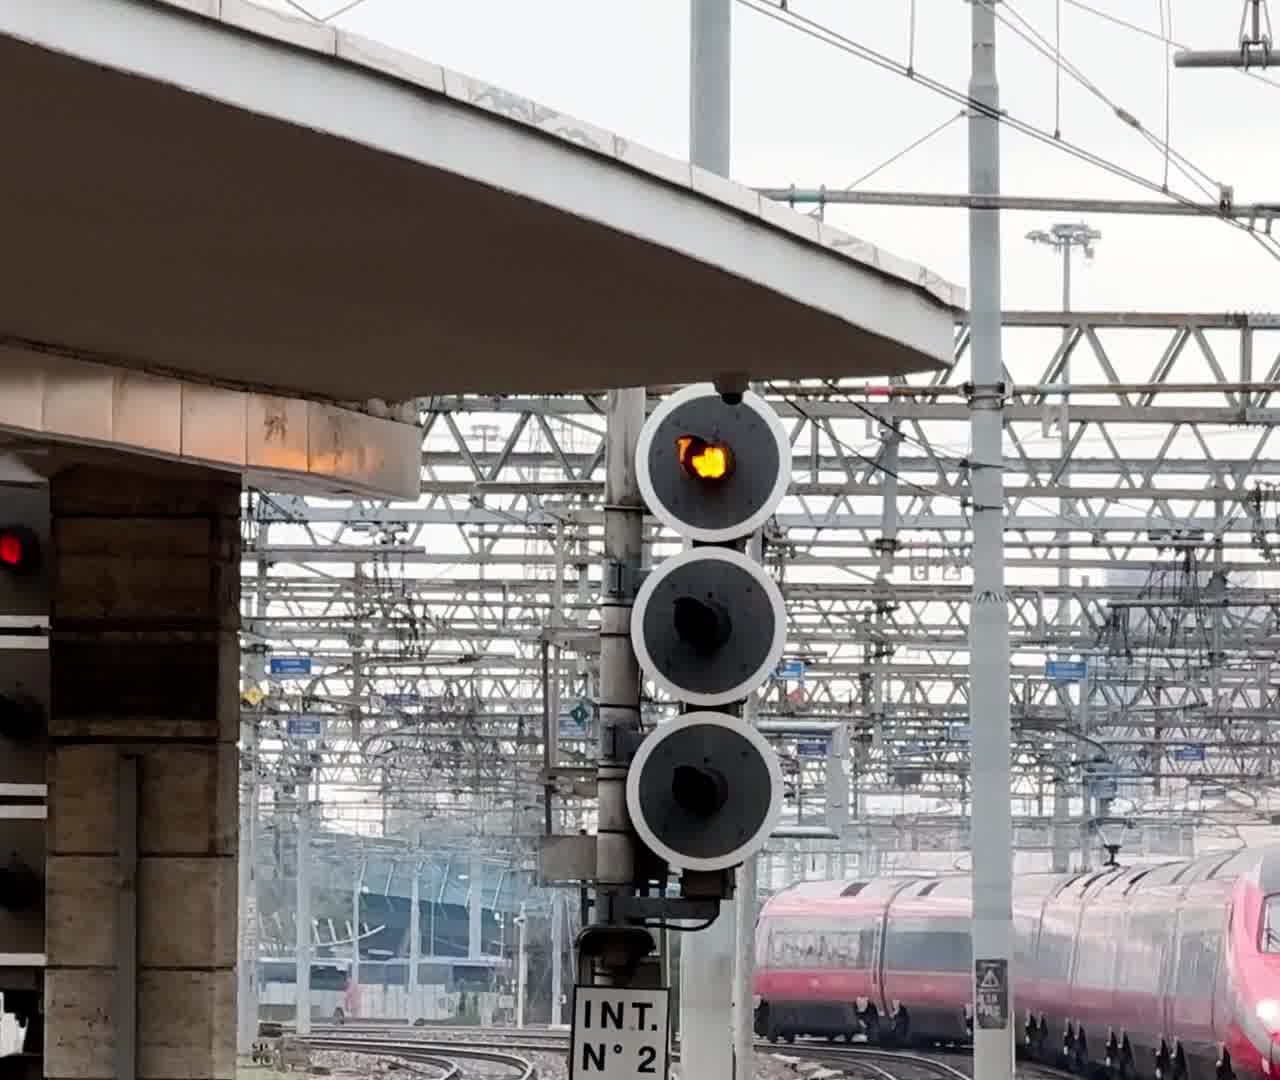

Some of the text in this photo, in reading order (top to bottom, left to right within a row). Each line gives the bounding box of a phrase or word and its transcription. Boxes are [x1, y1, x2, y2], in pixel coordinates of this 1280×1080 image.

[584, 1000, 658, 1031] INT.
[582, 1043, 658, 1074] N° 2
